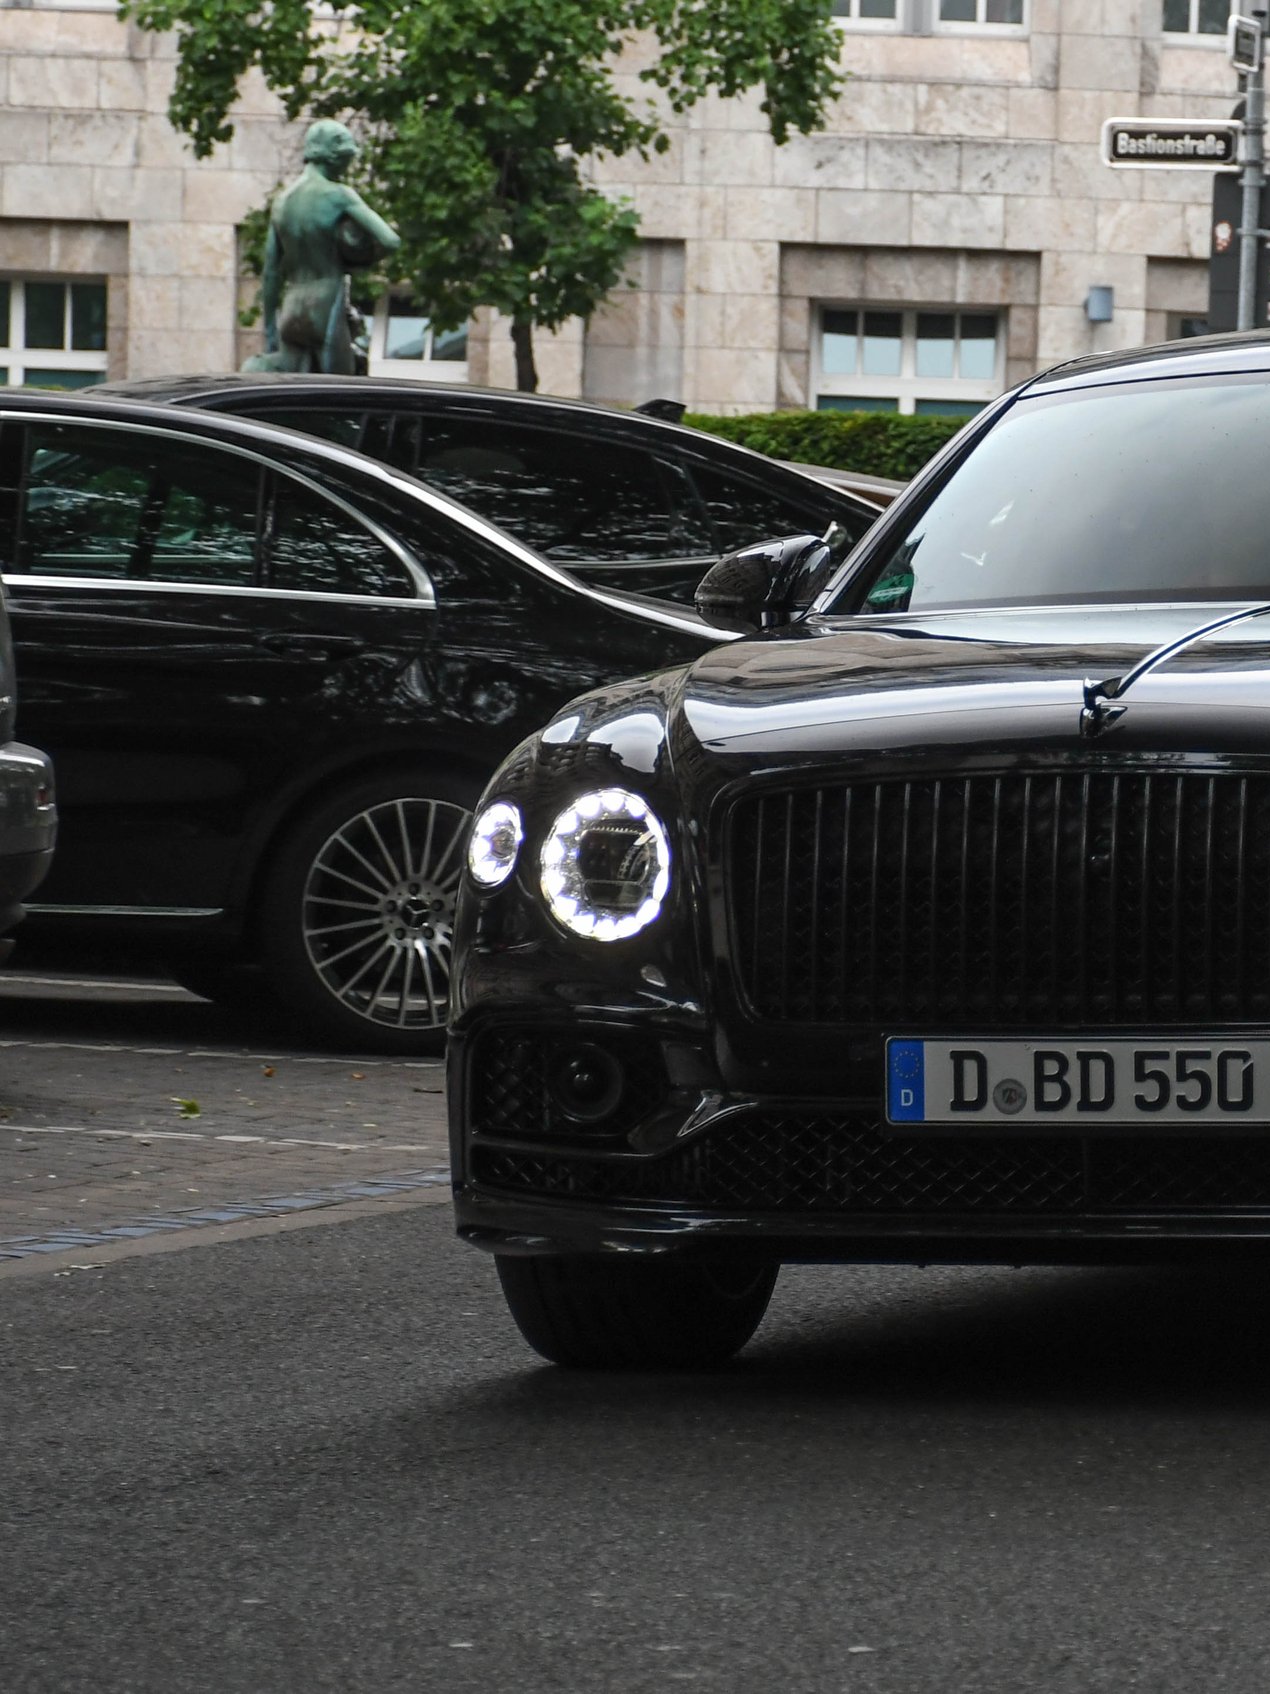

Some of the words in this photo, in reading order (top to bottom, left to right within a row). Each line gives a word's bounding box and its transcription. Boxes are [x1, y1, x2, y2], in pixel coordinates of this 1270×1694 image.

[1117, 132, 1226, 155] Bastionstraße
[949, 1050, 988, 1112] D
[1033, 1050, 1116, 1112] BD
[1133, 1050, 1254, 1112] 550
